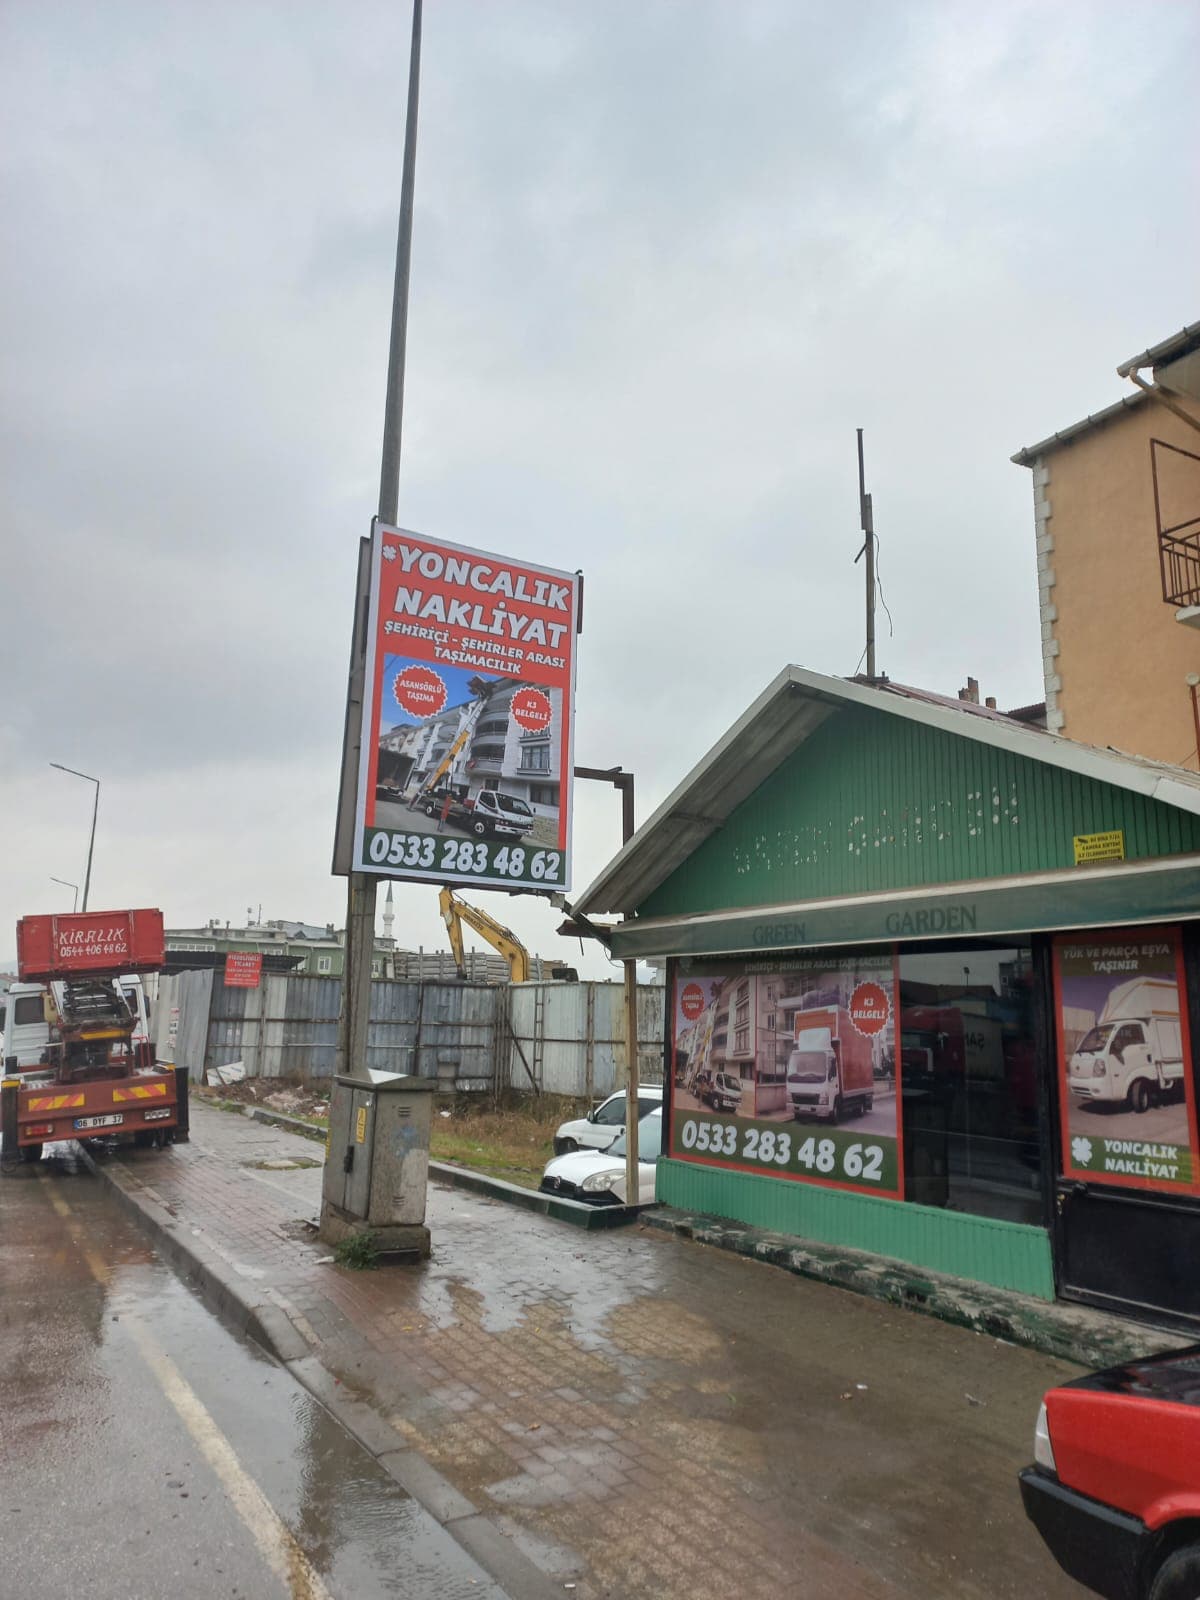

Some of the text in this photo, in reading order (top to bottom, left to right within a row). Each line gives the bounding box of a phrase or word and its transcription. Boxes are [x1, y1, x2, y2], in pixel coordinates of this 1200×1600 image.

[398, 544, 571, 612] YONCALIK
[393, 586, 568, 649] NAKLİYAT
[384, 620, 450, 643] ŞEHİRİÇİ
[461, 636, 524, 660] ŞEHİRLER
[524, 650, 566, 668] ARASI
[434, 645, 521, 674] TAŞIMACILIK
[369, 831, 561, 880] 0533 283 48 62
[59, 928, 125, 944] KİRALIK
[752, 904, 977, 945] GREEN GARDEN
[1086, 947, 1100, 958] VE
[1102, 946, 1139, 961] PARÇA
[1093, 959, 1139, 974] TAŞINIR
[852, 1008, 885, 1019] BELGELİ
[682, 1119, 884, 1182] 0533 283 48 62
[1104, 1139, 1178, 1161] YONCALIK
[1105, 1157, 1179, 1180] NAKLİYAT
